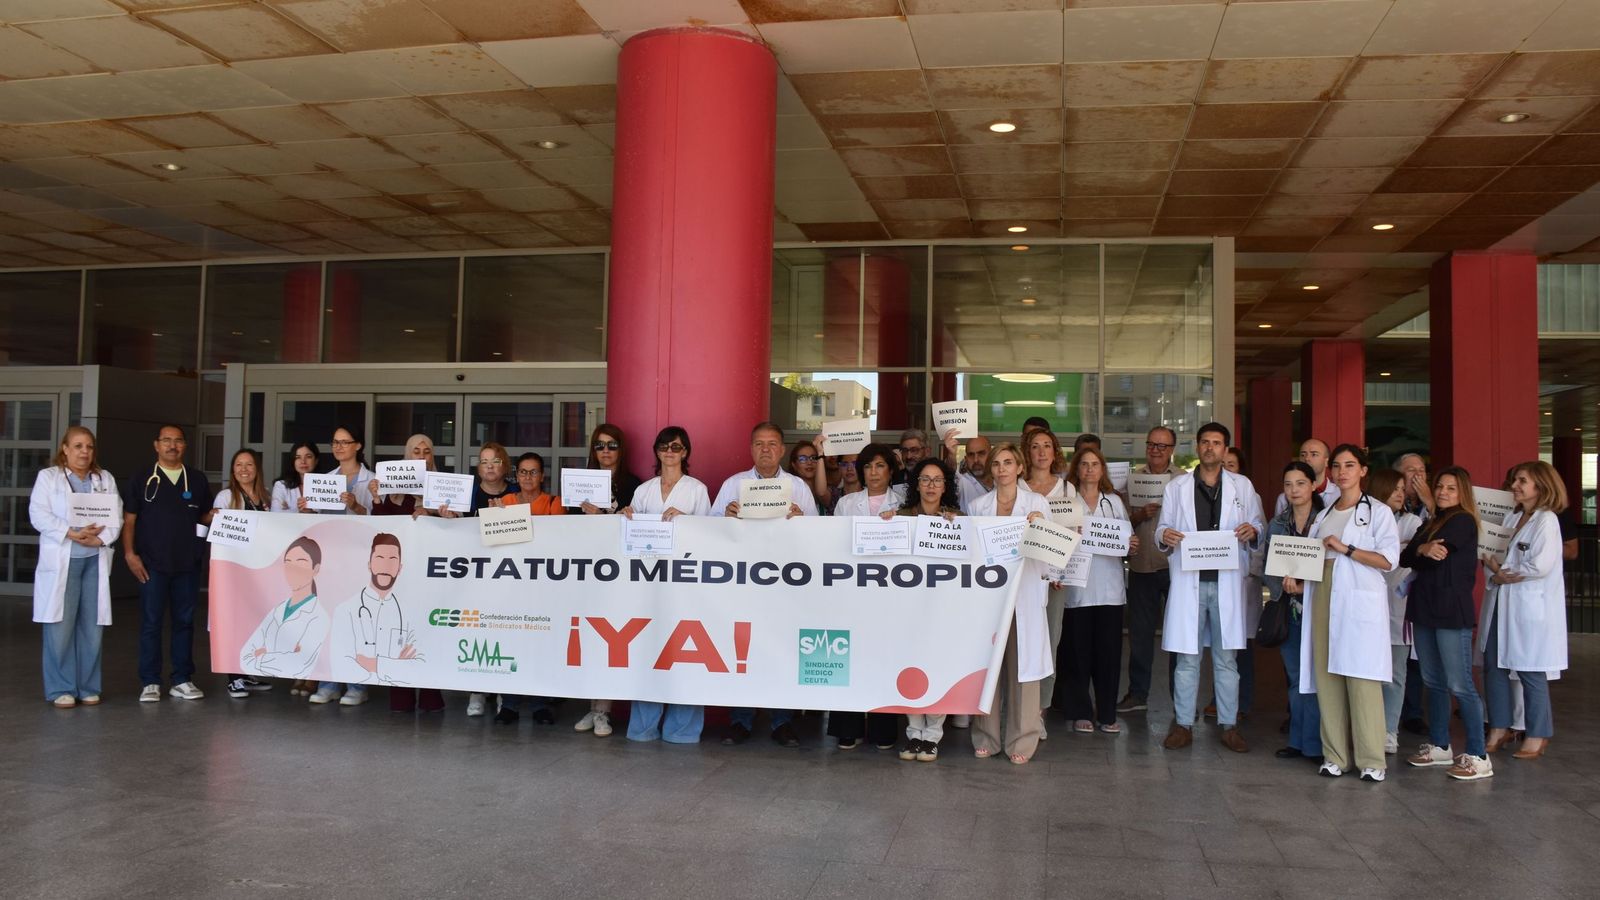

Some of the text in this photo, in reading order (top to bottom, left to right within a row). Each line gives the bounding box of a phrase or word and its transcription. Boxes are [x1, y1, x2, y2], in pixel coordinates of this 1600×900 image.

[221, 523, 246, 532] TIRANÍA
[1004, 525, 1025, 533] QUIERO
[226, 534, 250, 542] INGESA
[928, 532, 961, 540] TIRANÍA
[992, 534, 1020, 543] OPERARTE
[1044, 528, 1072, 542] VOCACIÓN
[1090, 530, 1120, 540] TIRANÍA
[919, 541, 967, 551] DEL INGESA
[1030, 542, 1066, 556] EXPLOTACIÓN
[1098, 542, 1126, 550] INGESA
[426, 552, 1008, 589] ESTATUTO MÉDICO PROPIO
[428, 608, 480, 627] CESM
[566, 616, 752, 674] ¡YA!
[800, 630, 849, 659] SMC
[458, 638, 502, 667] SMA
